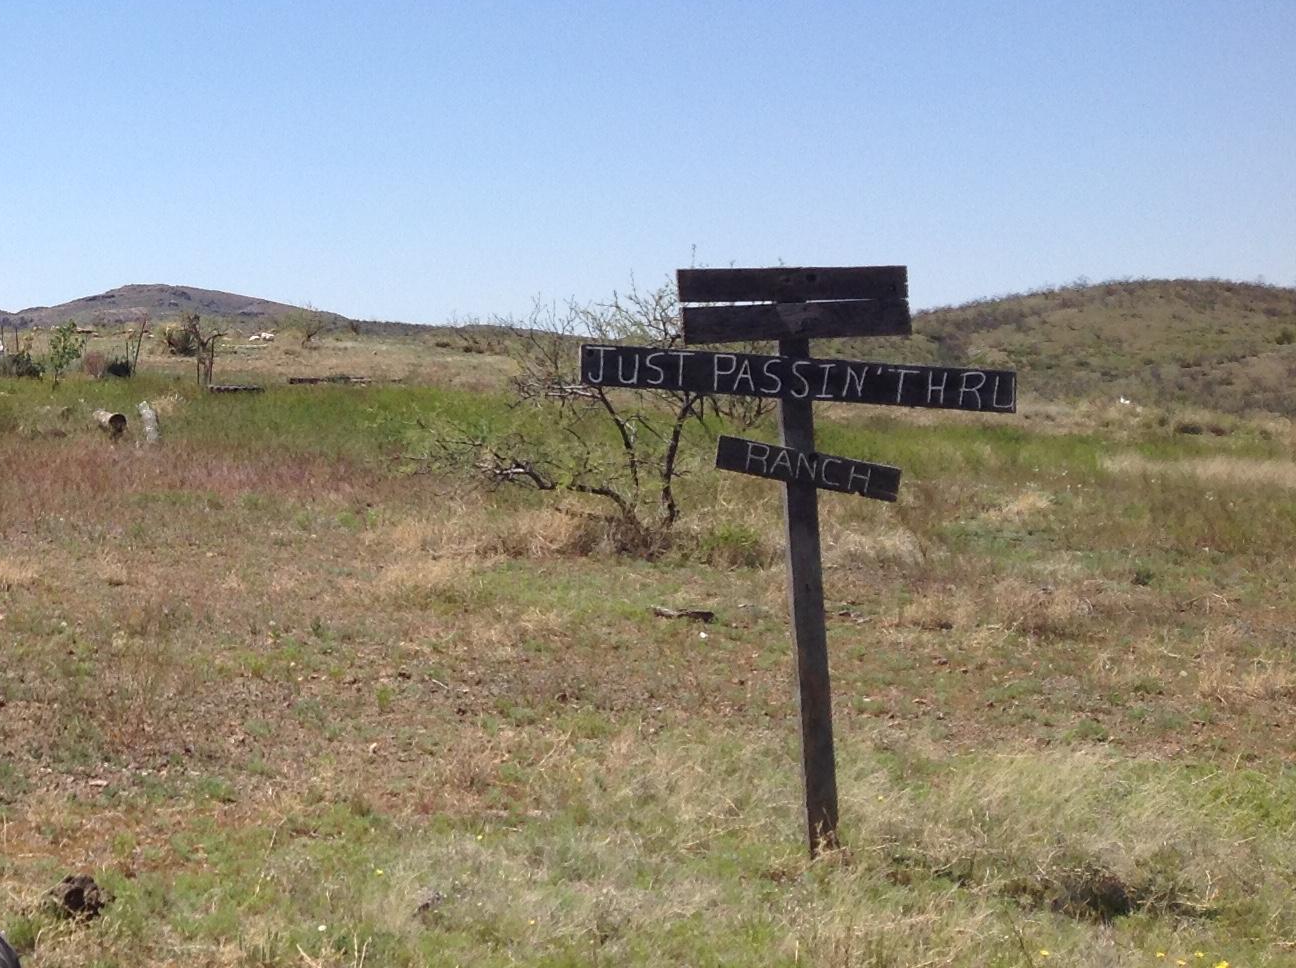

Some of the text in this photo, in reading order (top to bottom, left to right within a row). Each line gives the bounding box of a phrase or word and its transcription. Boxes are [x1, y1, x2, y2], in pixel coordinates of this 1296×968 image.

[586, 346, 695, 386] JUST
[888, 369, 1016, 411] THRU
[745, 441, 871, 493] RANCH
